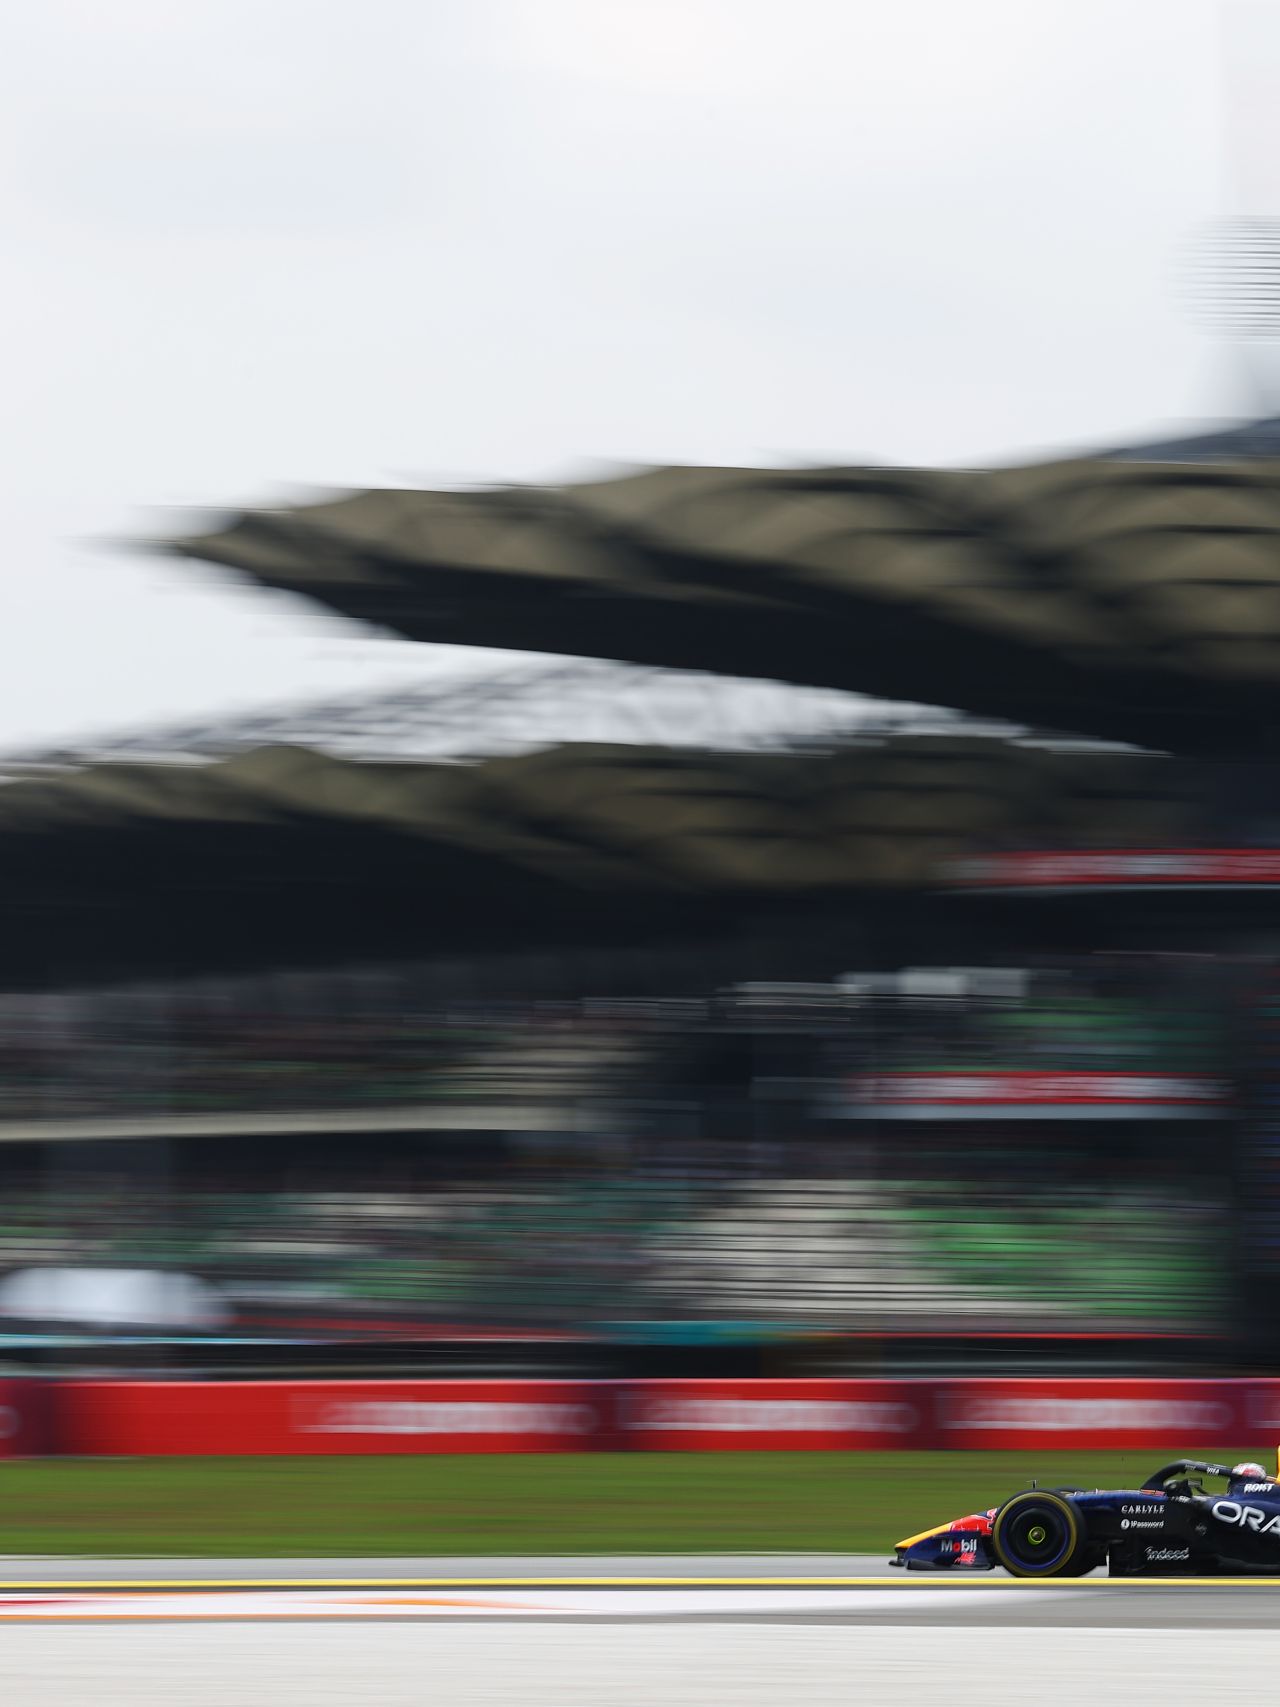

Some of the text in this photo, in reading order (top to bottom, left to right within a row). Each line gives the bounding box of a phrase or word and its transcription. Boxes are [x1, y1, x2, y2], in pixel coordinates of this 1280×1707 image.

[1121, 1504, 1165, 1514] CARLYLE
[1130, 1520, 1165, 1529] 1Password
[941, 1539, 977, 1552] Mobil
